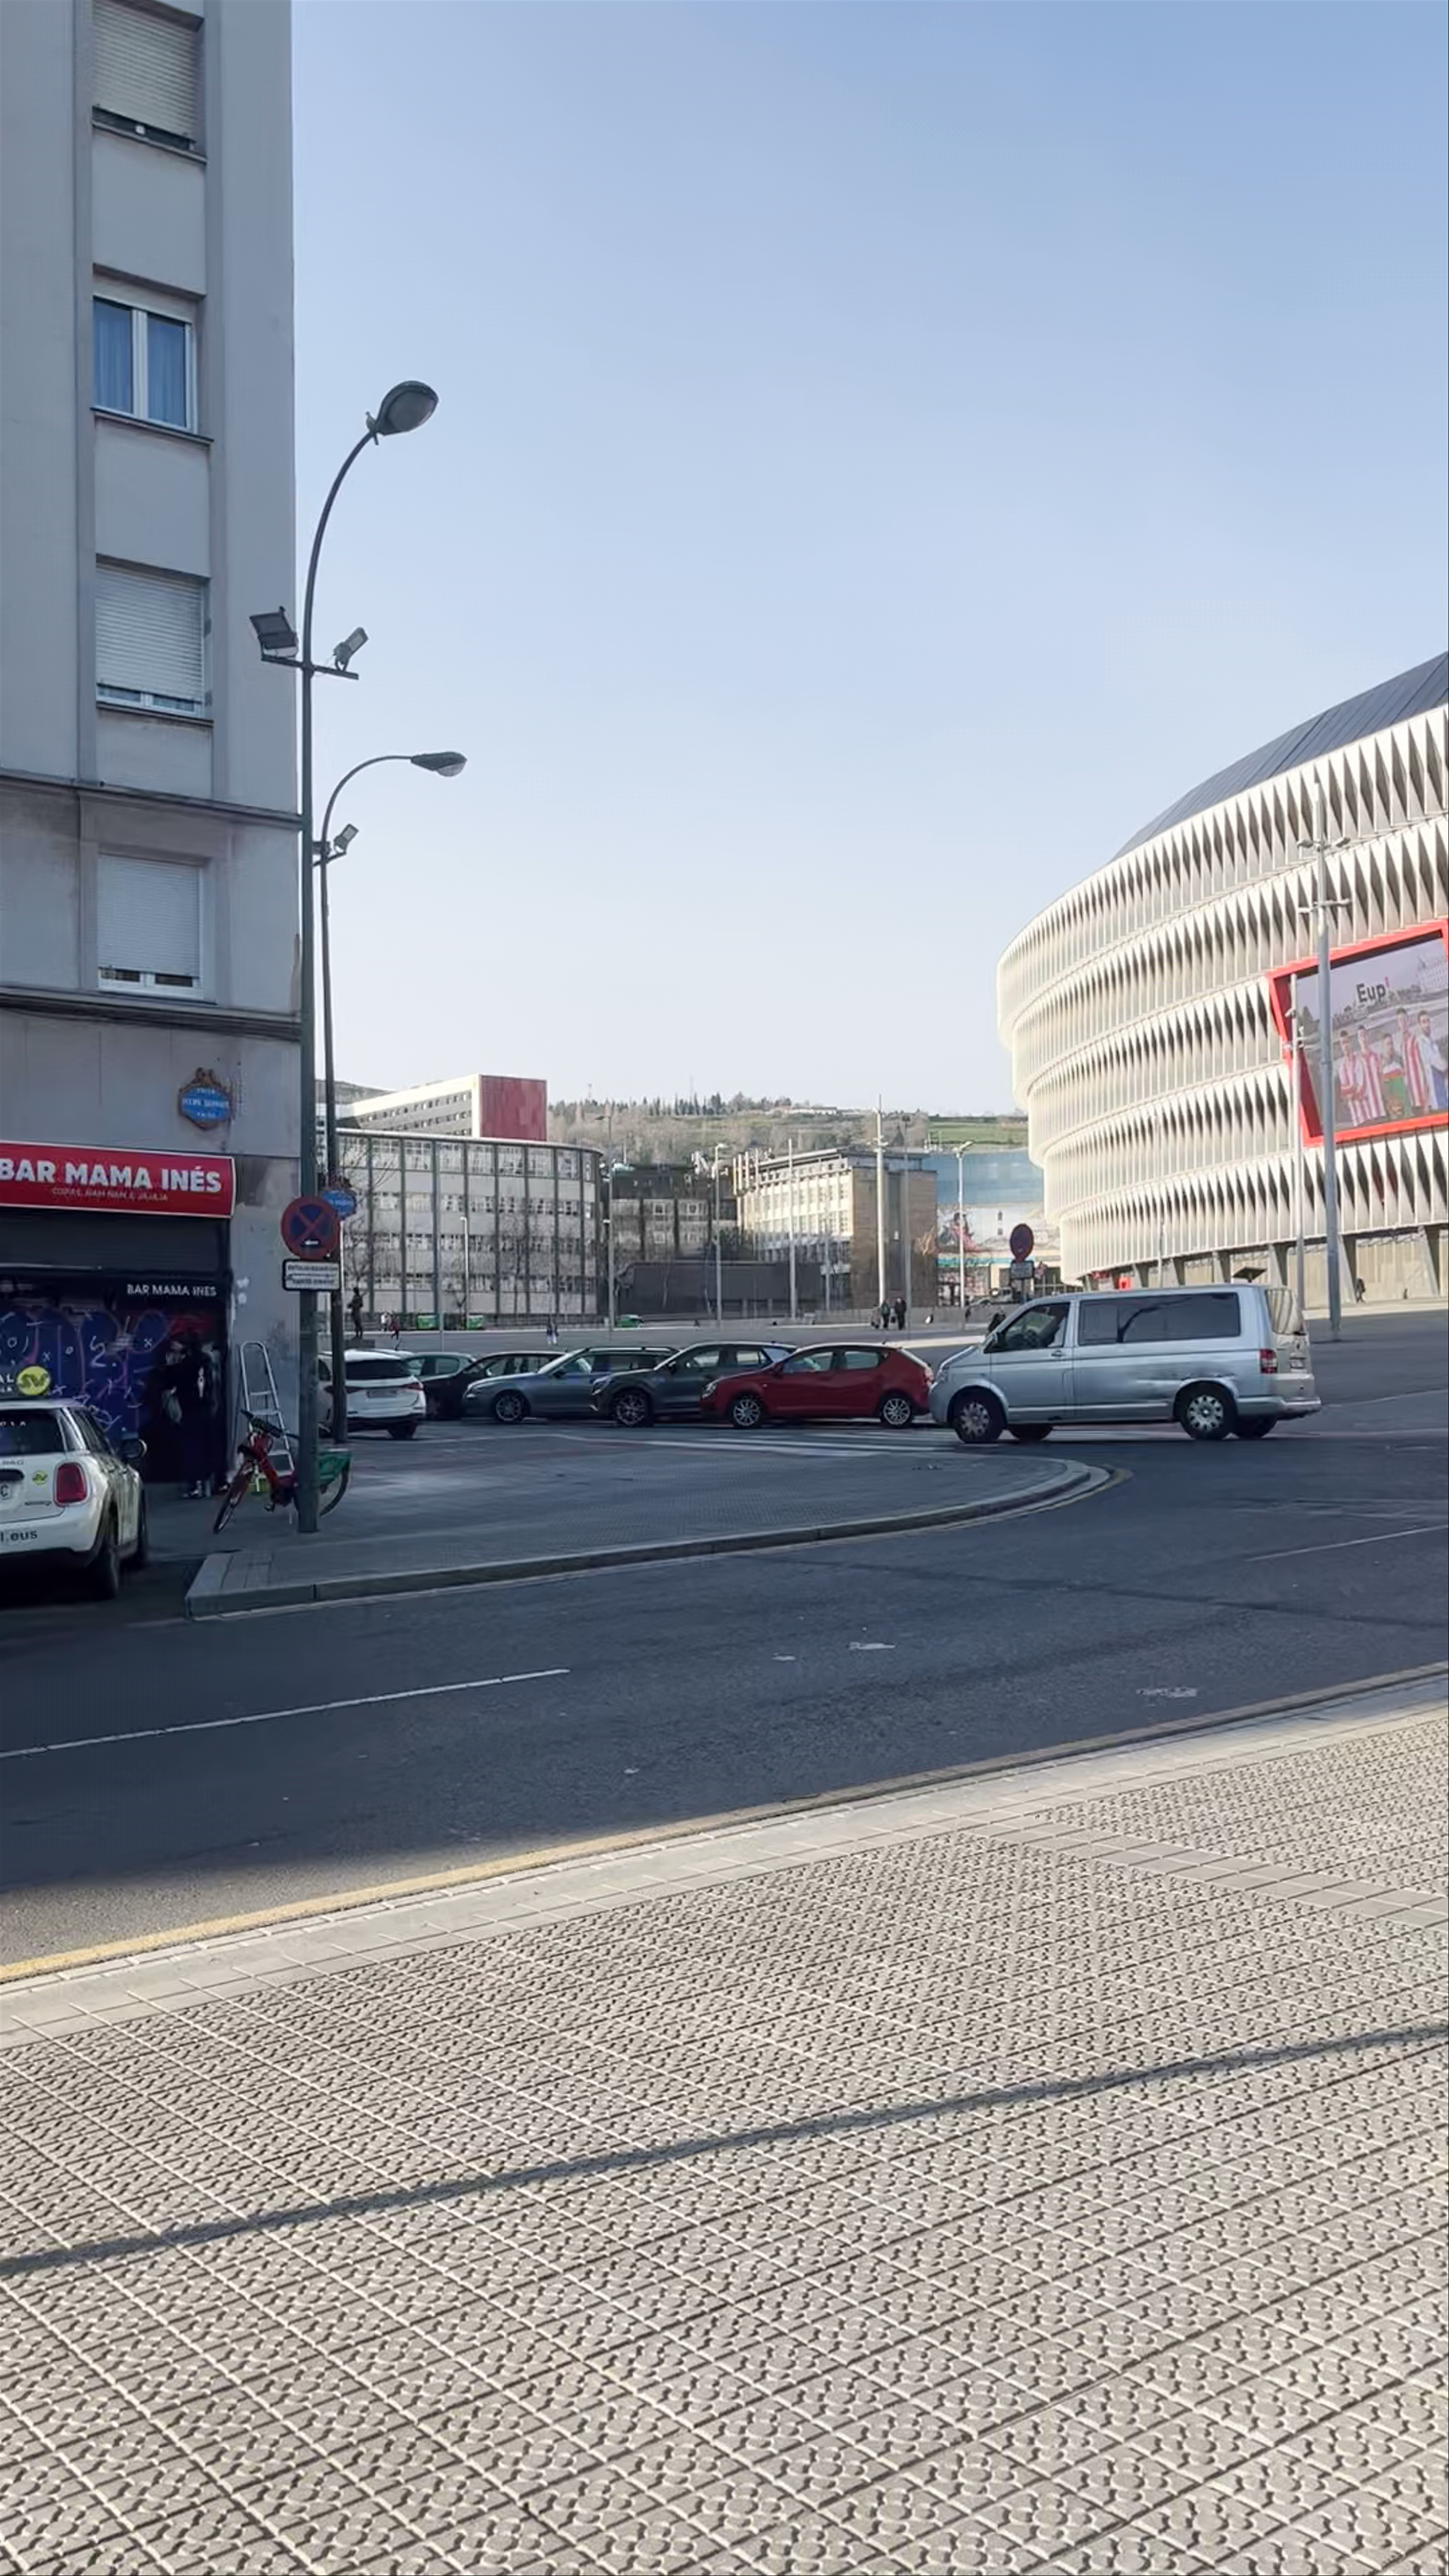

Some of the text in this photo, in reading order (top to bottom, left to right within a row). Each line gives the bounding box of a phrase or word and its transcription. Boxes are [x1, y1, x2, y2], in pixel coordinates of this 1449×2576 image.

[0, 1158, 222, 1193] BAR MAMA INÉS
[127, 1284, 149, 1295] BAR
[152, 1284, 190, 1295] MAMA
